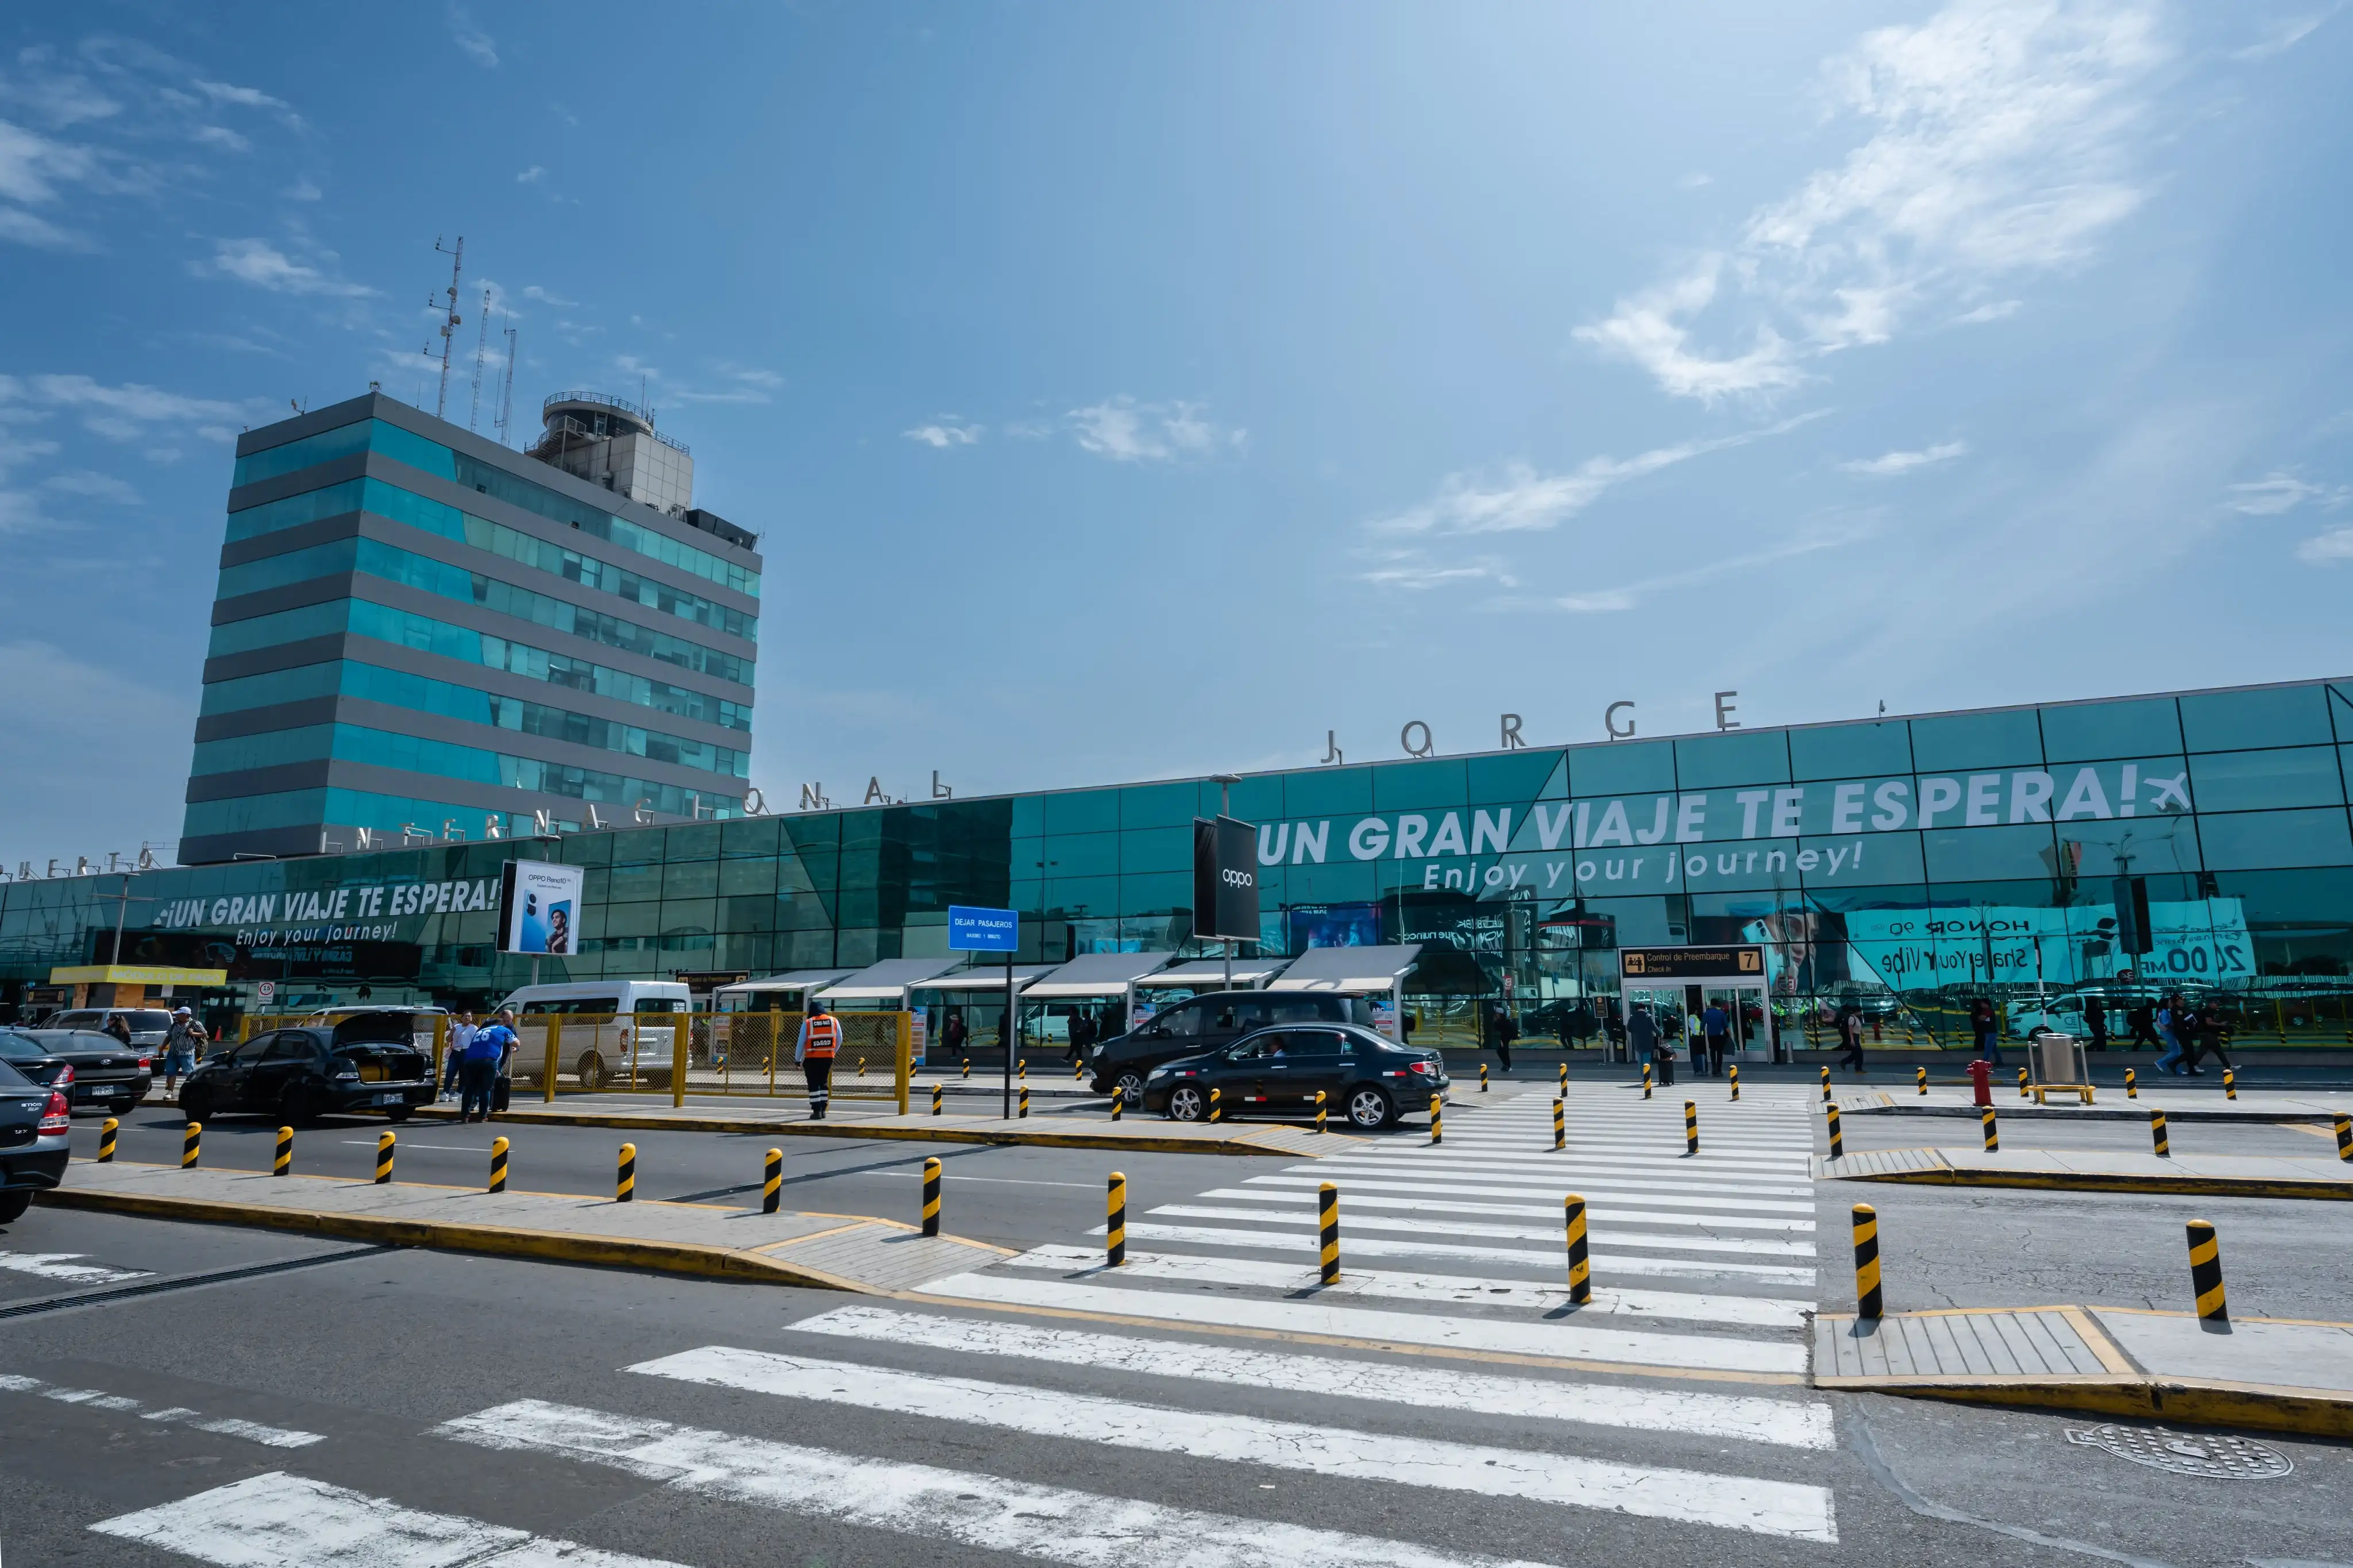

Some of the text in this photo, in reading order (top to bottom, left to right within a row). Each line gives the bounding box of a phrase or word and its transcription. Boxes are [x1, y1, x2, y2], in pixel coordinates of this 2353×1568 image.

[1349, 808, 1511, 861] GRAN
[1534, 795, 1707, 850] VIAJE
[1735, 787, 1804, 839] TE
[1831, 764, 2138, 835] ESPERA!
[0, 848, 153, 880] UERTO
[1424, 841, 1862, 893] Enjoy your journey!
[211, 894, 276, 925] GRAN
[285, 890, 350, 921] VIAJE
[357, 886, 384, 917] TE
[389, 878, 499, 916] ESPERA!
[236, 922, 396, 947] Enjoy your journey!
[955, 918, 1013, 928] DEJAR PASAJEROS
[1647, 951, 1753, 968] Control de Preembarque 7
[169, 971, 186, 982] DE
[188, 972, 221, 983] PAGO
[473, 1029, 491, 1042] 26
